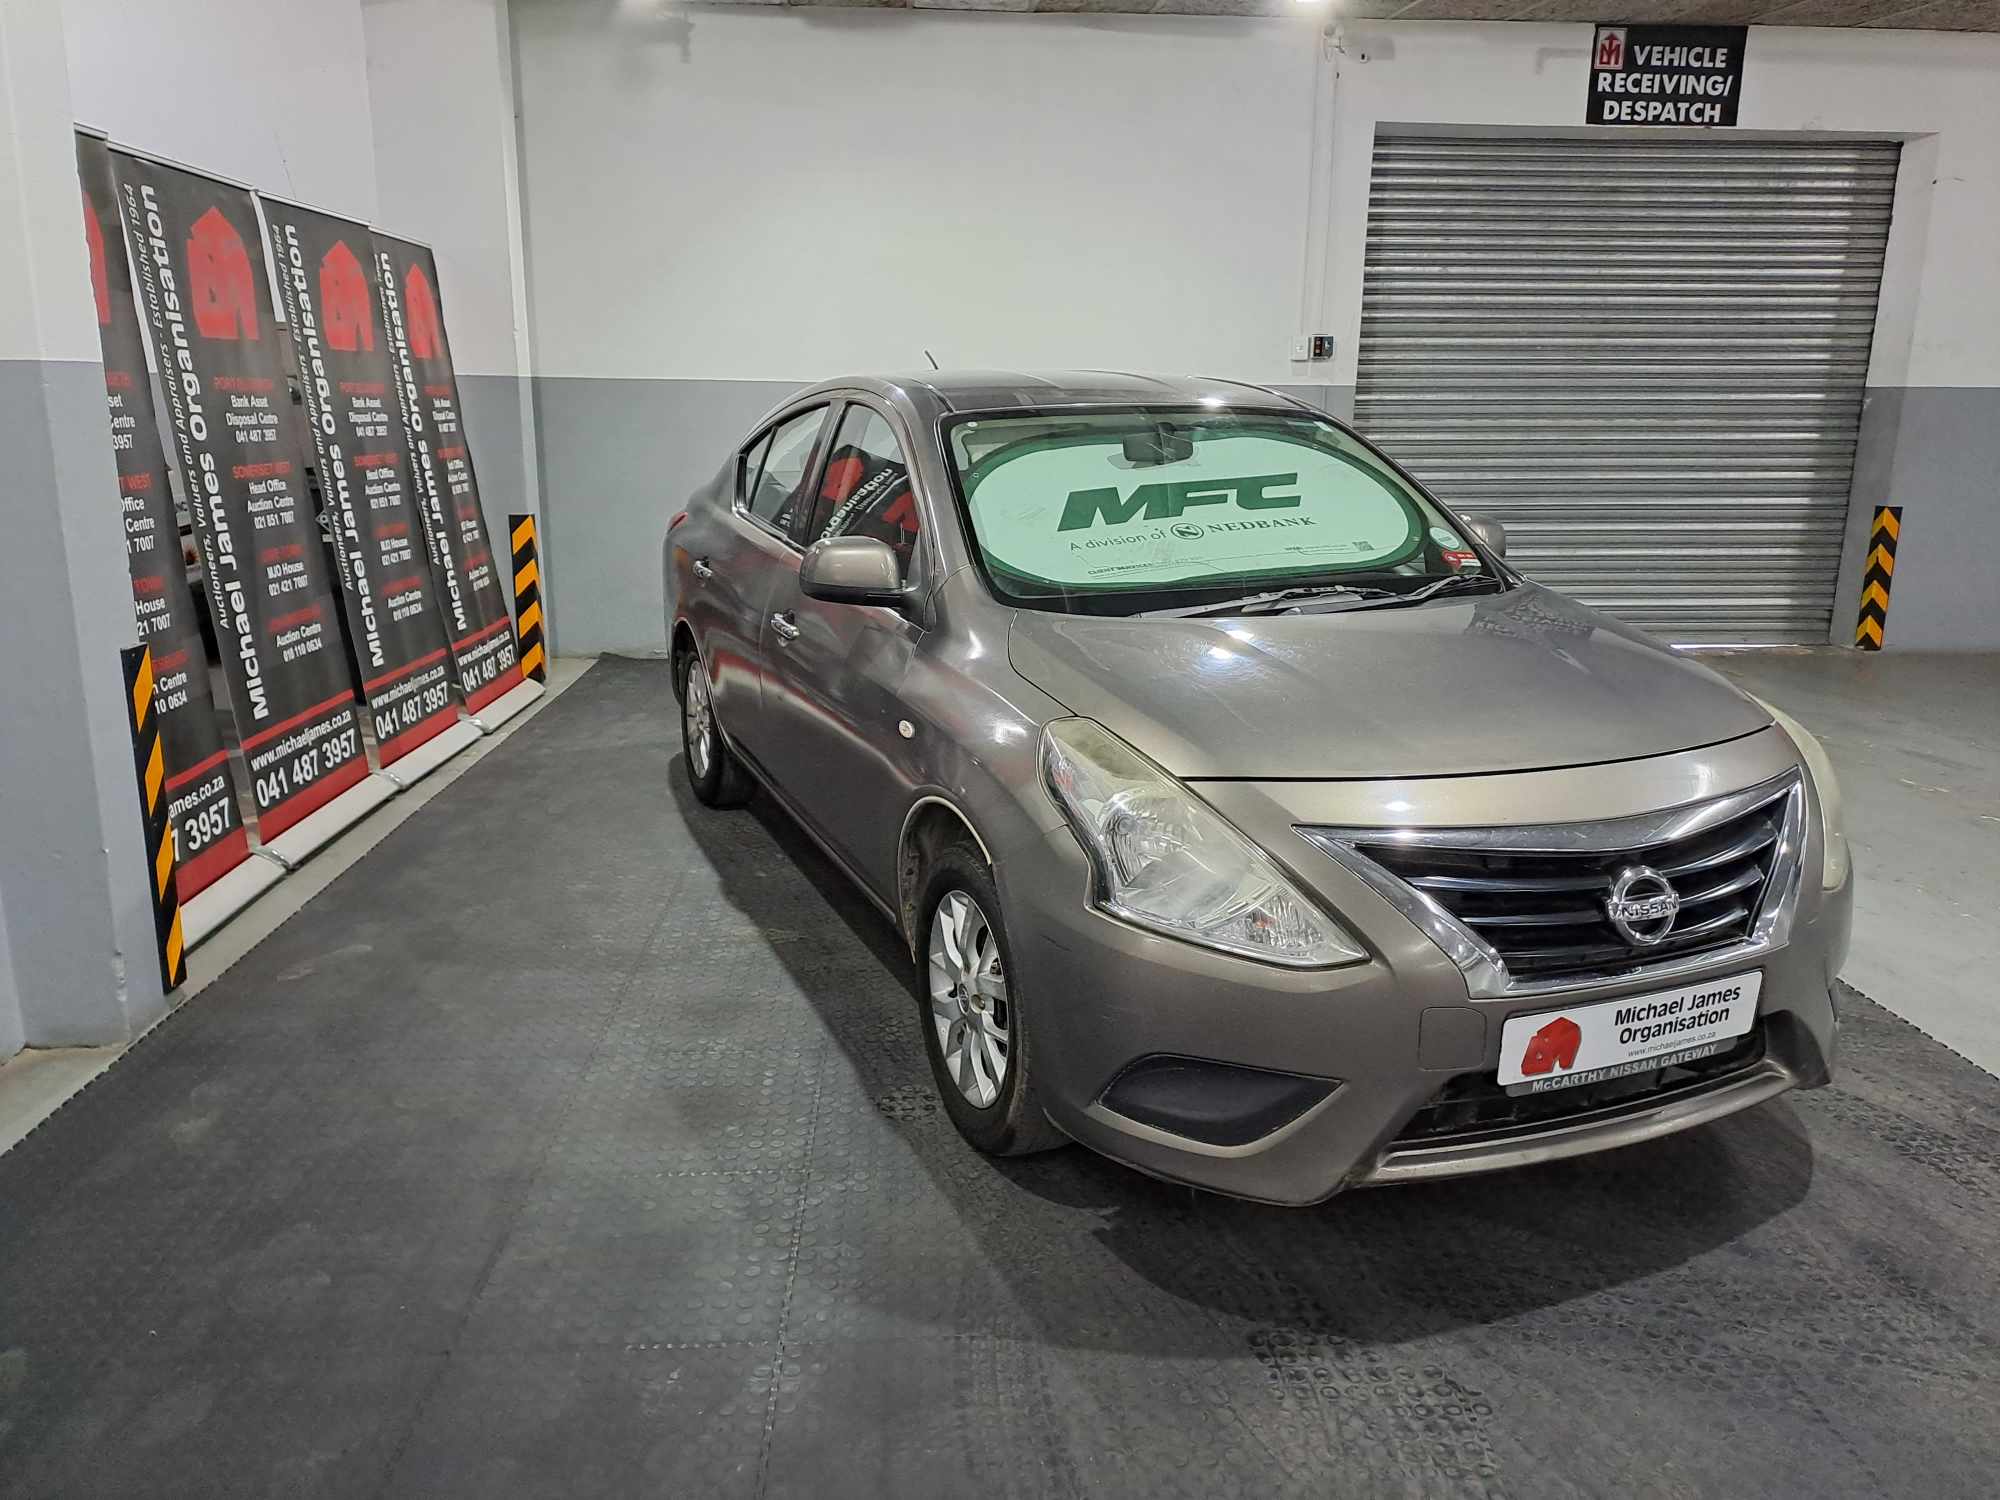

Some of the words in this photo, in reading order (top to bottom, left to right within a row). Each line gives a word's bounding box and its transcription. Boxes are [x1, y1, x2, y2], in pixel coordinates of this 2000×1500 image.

[1633, 45, 1727, 68] VEHICLE
[1597, 73, 1733, 96] RECEIVING/
[1603, 101, 1721, 123] DESPATCH
[123, 183, 141, 225] 1964
[133, 230, 163, 329] Established
[279, 261, 301, 342] Established
[140, 185, 207, 441] Organisation
[285, 225, 336, 435] Organisation
[381, 253, 423, 432] Organisation
[108, 394, 123, 407] set
[160, 343, 186, 430] Appraisers
[112, 415, 136, 429] entre
[312, 427, 325, 455] and
[178, 432, 193, 465] and
[187, 469, 207, 528] Valuers
[320, 458, 336, 506] Valuers
[329, 444, 359, 543] James
[418, 440, 443, 525] James
[1057, 472, 1301, 532] MFC
[125, 516, 155, 533] Centre
[199, 452, 238, 571] James
[1070, 542, 1082, 551] A
[1086, 535, 1146, 548] division
[1151, 529, 1167, 540] of
[1207, 517, 1316, 532] NEDBANK
[436, 531, 467, 631] Michael
[135, 598, 166, 615] House
[136, 620, 149, 637] 21
[349, 551, 385, 667] Michael
[224, 581, 269, 720] Michael
[462, 665, 481, 692] 041
[482, 656, 496, 680] 487
[159, 671, 187, 692] Centre
[155, 699, 167, 715] 10
[375, 707, 399, 739] 041
[402, 694, 421, 724] 487
[423, 681, 448, 712] 3957
[256, 767, 288, 807] 041
[293, 749, 319, 785] 487
[322, 728, 356, 769] 3957
[185, 797, 230, 850] 3957
[1621, 900, 1678, 917] NISSAN
[1615, 996, 1684, 1026] Michael
[1687, 986, 1741, 1011] James
[1620, 1007, 1730, 1044] Organisation
[1532, 1069, 1607, 1092] McCARTHY
[1609, 1060, 1658, 1078] NISSAN
[1661, 1044, 1718, 1066] GATEWAY
